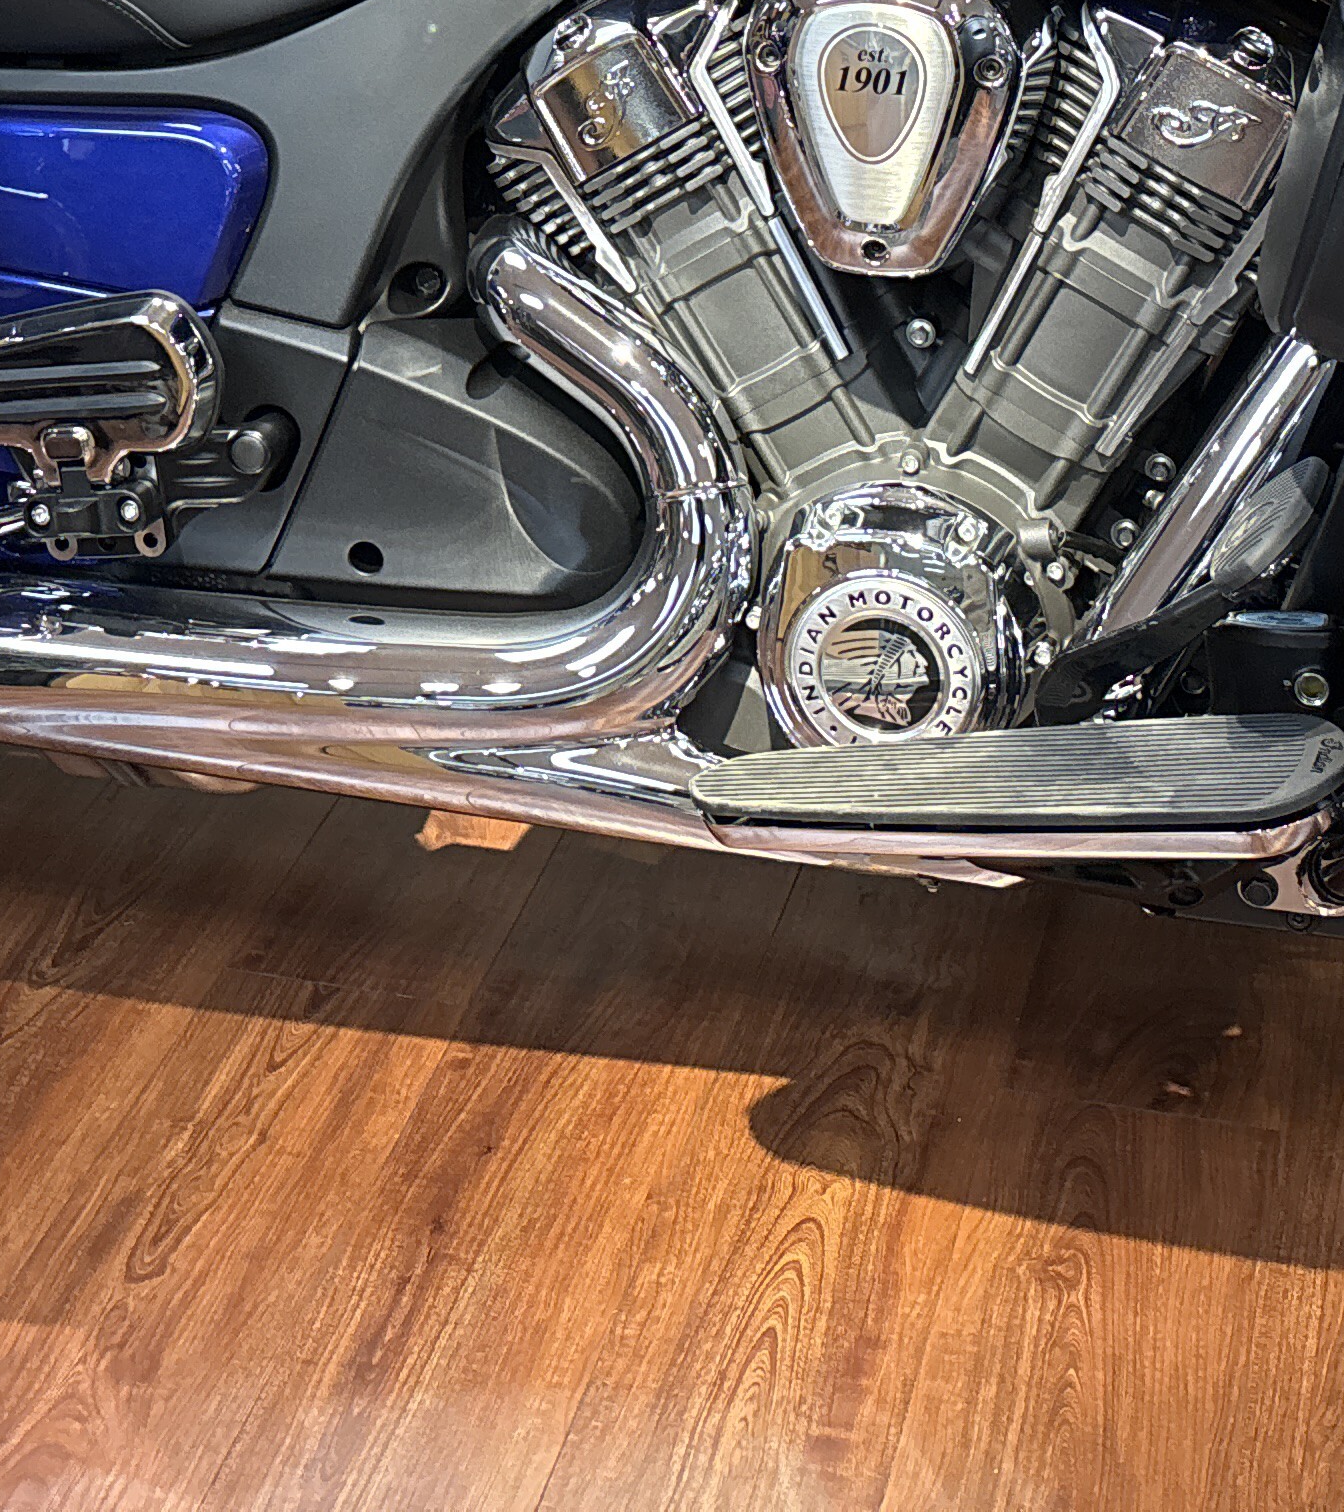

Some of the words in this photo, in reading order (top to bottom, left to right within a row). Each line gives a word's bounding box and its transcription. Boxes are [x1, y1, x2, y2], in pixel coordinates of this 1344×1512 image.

[857, 47, 889, 64] est.
[836, 65, 909, 96] 1901
[798, 604, 838, 716] INDIAN
[846, 589, 970, 737] MOTORCYCLE
